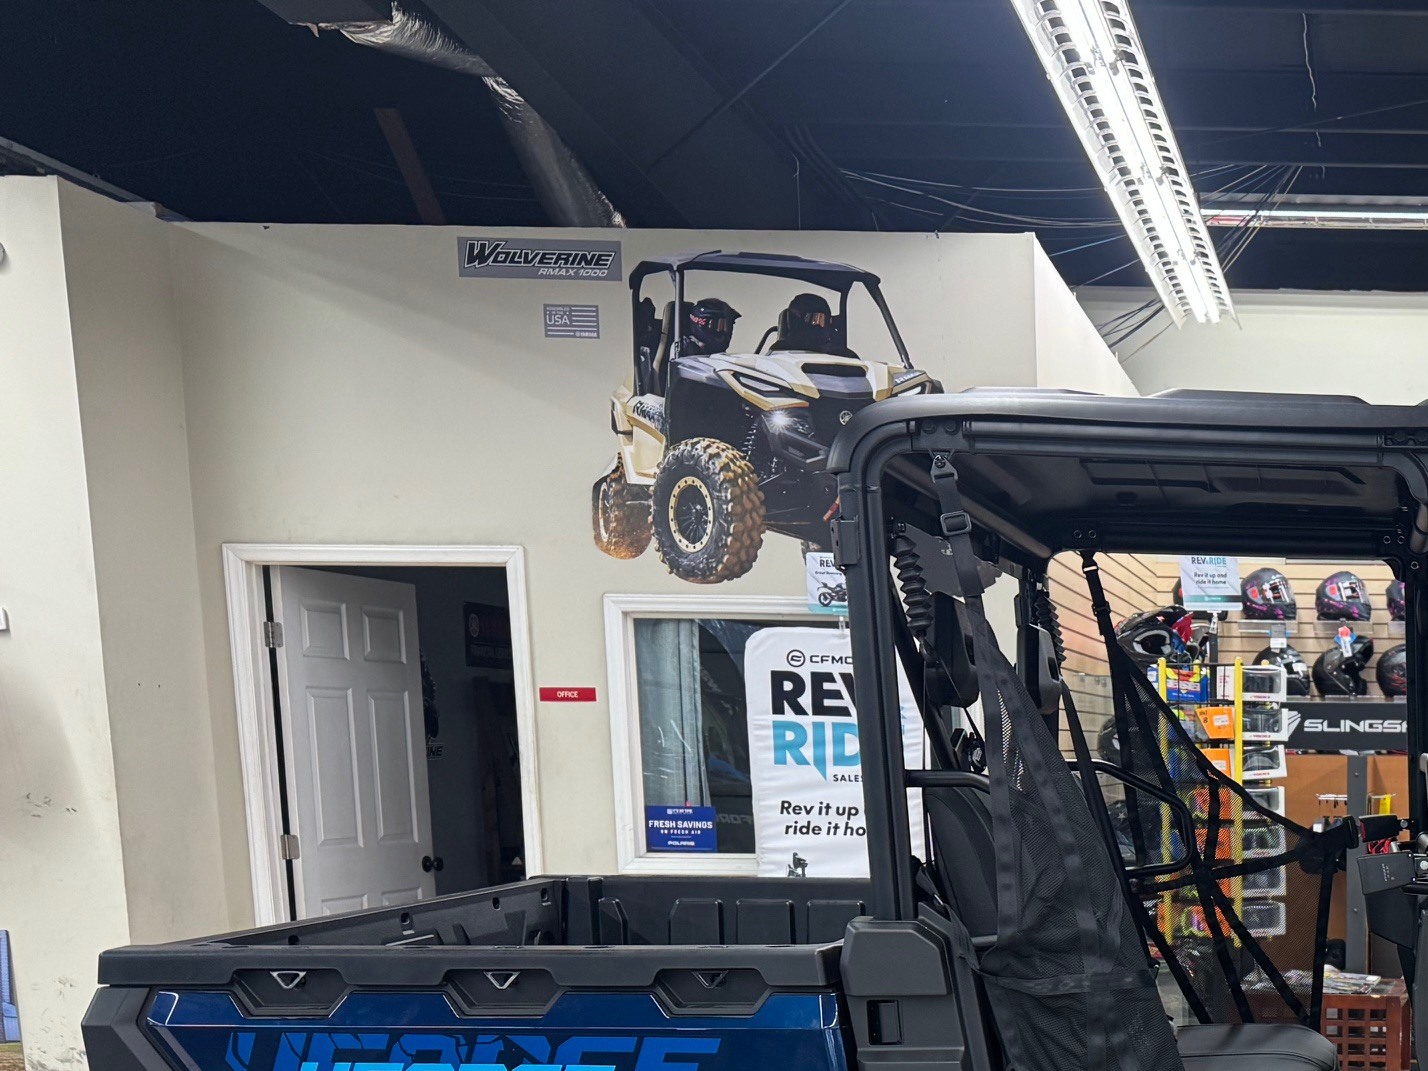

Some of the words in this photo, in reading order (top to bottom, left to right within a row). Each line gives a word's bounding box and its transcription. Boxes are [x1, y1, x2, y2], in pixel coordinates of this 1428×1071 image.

[464, 240, 616, 269] WOLVERINE
[538, 268, 576, 276] RMAX
[579, 269, 608, 277] 1000
[546, 315, 570, 325] USA
[810, 655, 853, 665] CFMO
[1303, 719, 1407, 733] SLINGS
[772, 720, 861, 782] RID
[780, 800, 815, 815] Rev
[818, 801, 831, 816] it
[835, 804, 859, 822] up
[648, 820, 676, 828] FRESH
[677, 820, 713, 829] SAVINGS
[784, 821, 822, 836] ride
[826, 821, 840, 836] it
[843, 822, 867, 837] ho
